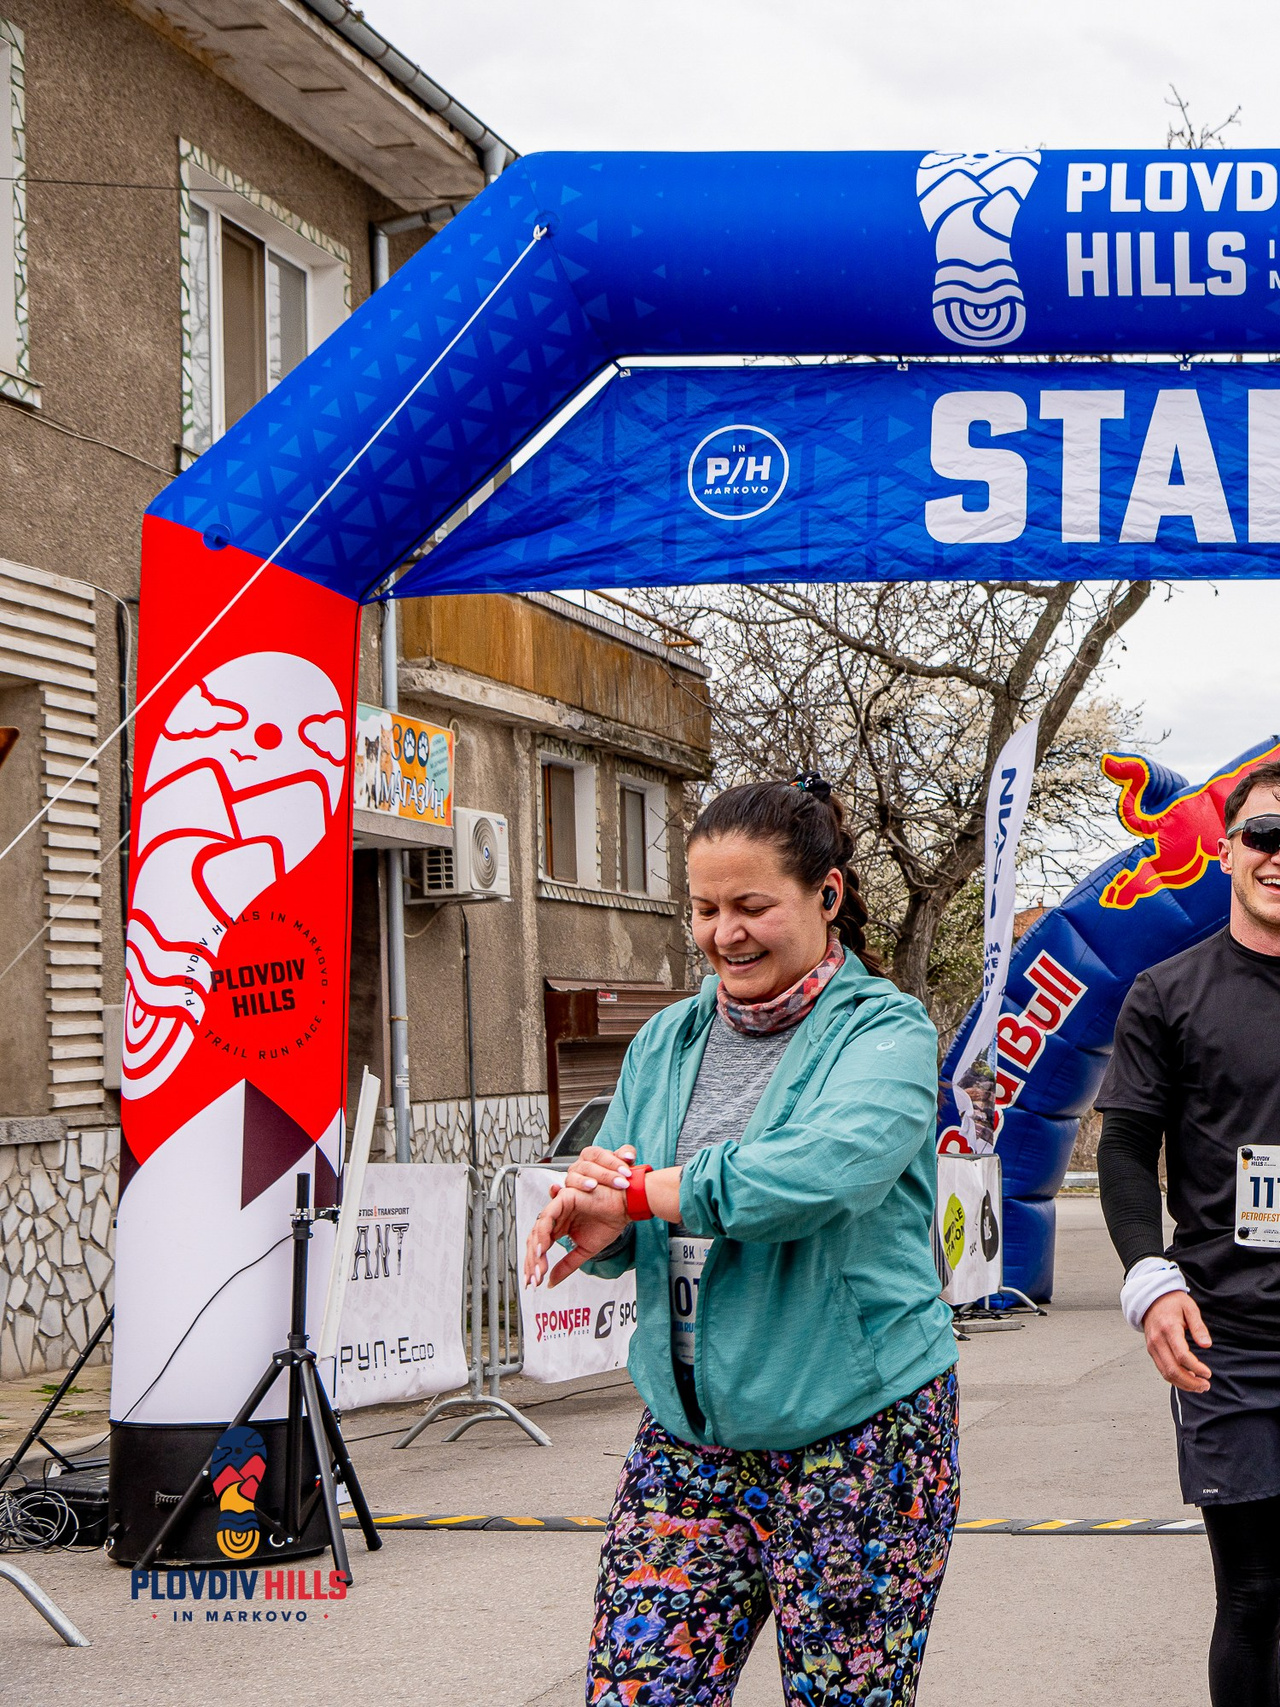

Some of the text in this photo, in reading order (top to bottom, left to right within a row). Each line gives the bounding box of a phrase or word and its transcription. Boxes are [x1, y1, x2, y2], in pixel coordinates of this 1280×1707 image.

[1066, 231, 1247, 296] HILLS
[732, 445, 746, 453] IN
[706, 455, 772, 485] P/H
[704, 486, 769, 495] MARKOVO
[380, 770, 445, 818] МАГАЗИН
[184, 911, 328, 1006] PLOVDIV HILLS IN MARKOVO
[210, 958, 305, 992] PLOVDIV
[232, 988, 296, 1018] HILLS
[997, 954, 1082, 1068] Bull
[204, 1015, 322, 1060] TRAIL RUN RACE
[377, 1207, 410, 1216] TRANSPORT
[683, 1245, 695, 1258] 8K
[535, 1307, 591, 1342] SPONSER
